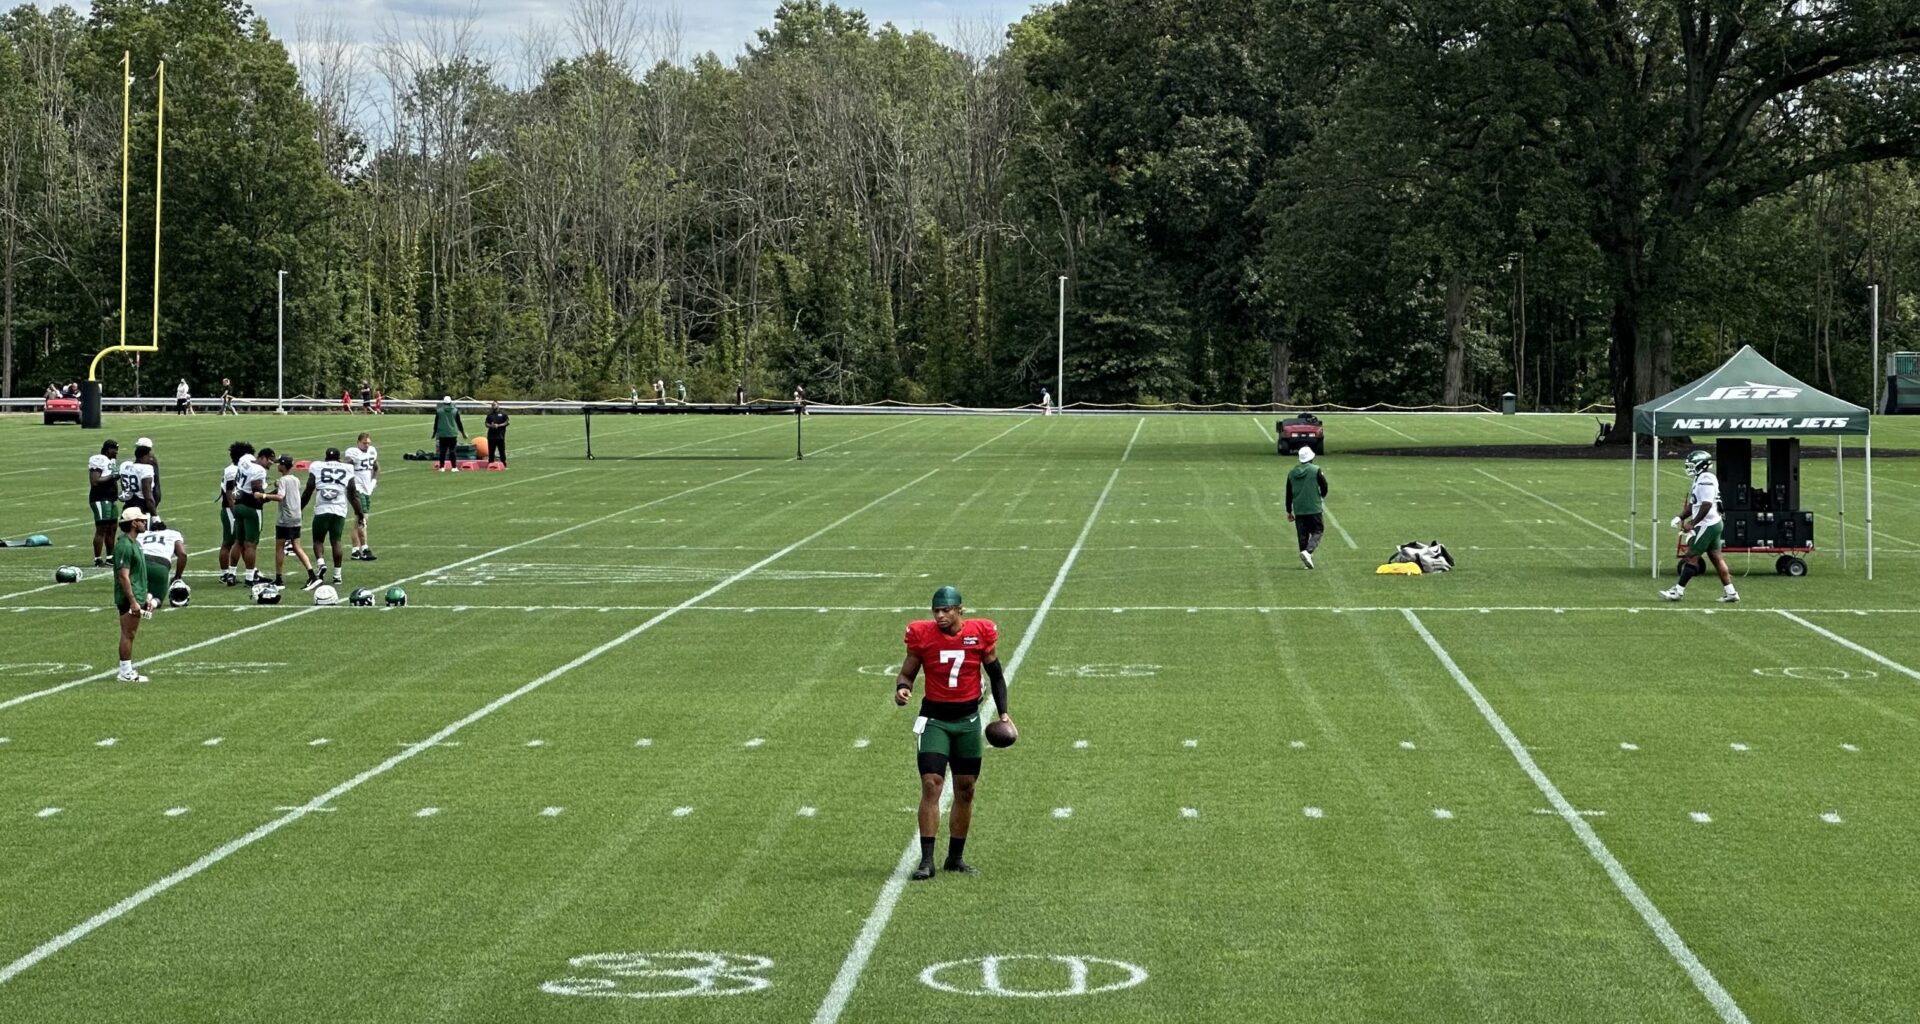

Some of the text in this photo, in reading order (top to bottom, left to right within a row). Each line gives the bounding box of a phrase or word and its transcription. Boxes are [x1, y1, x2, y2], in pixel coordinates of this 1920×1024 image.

[1695, 383, 1803, 401] JETS
[1672, 417, 1849, 430] NEW YORK JETS
[320, 468, 347, 487] 62
[939, 649, 965, 688] 7
